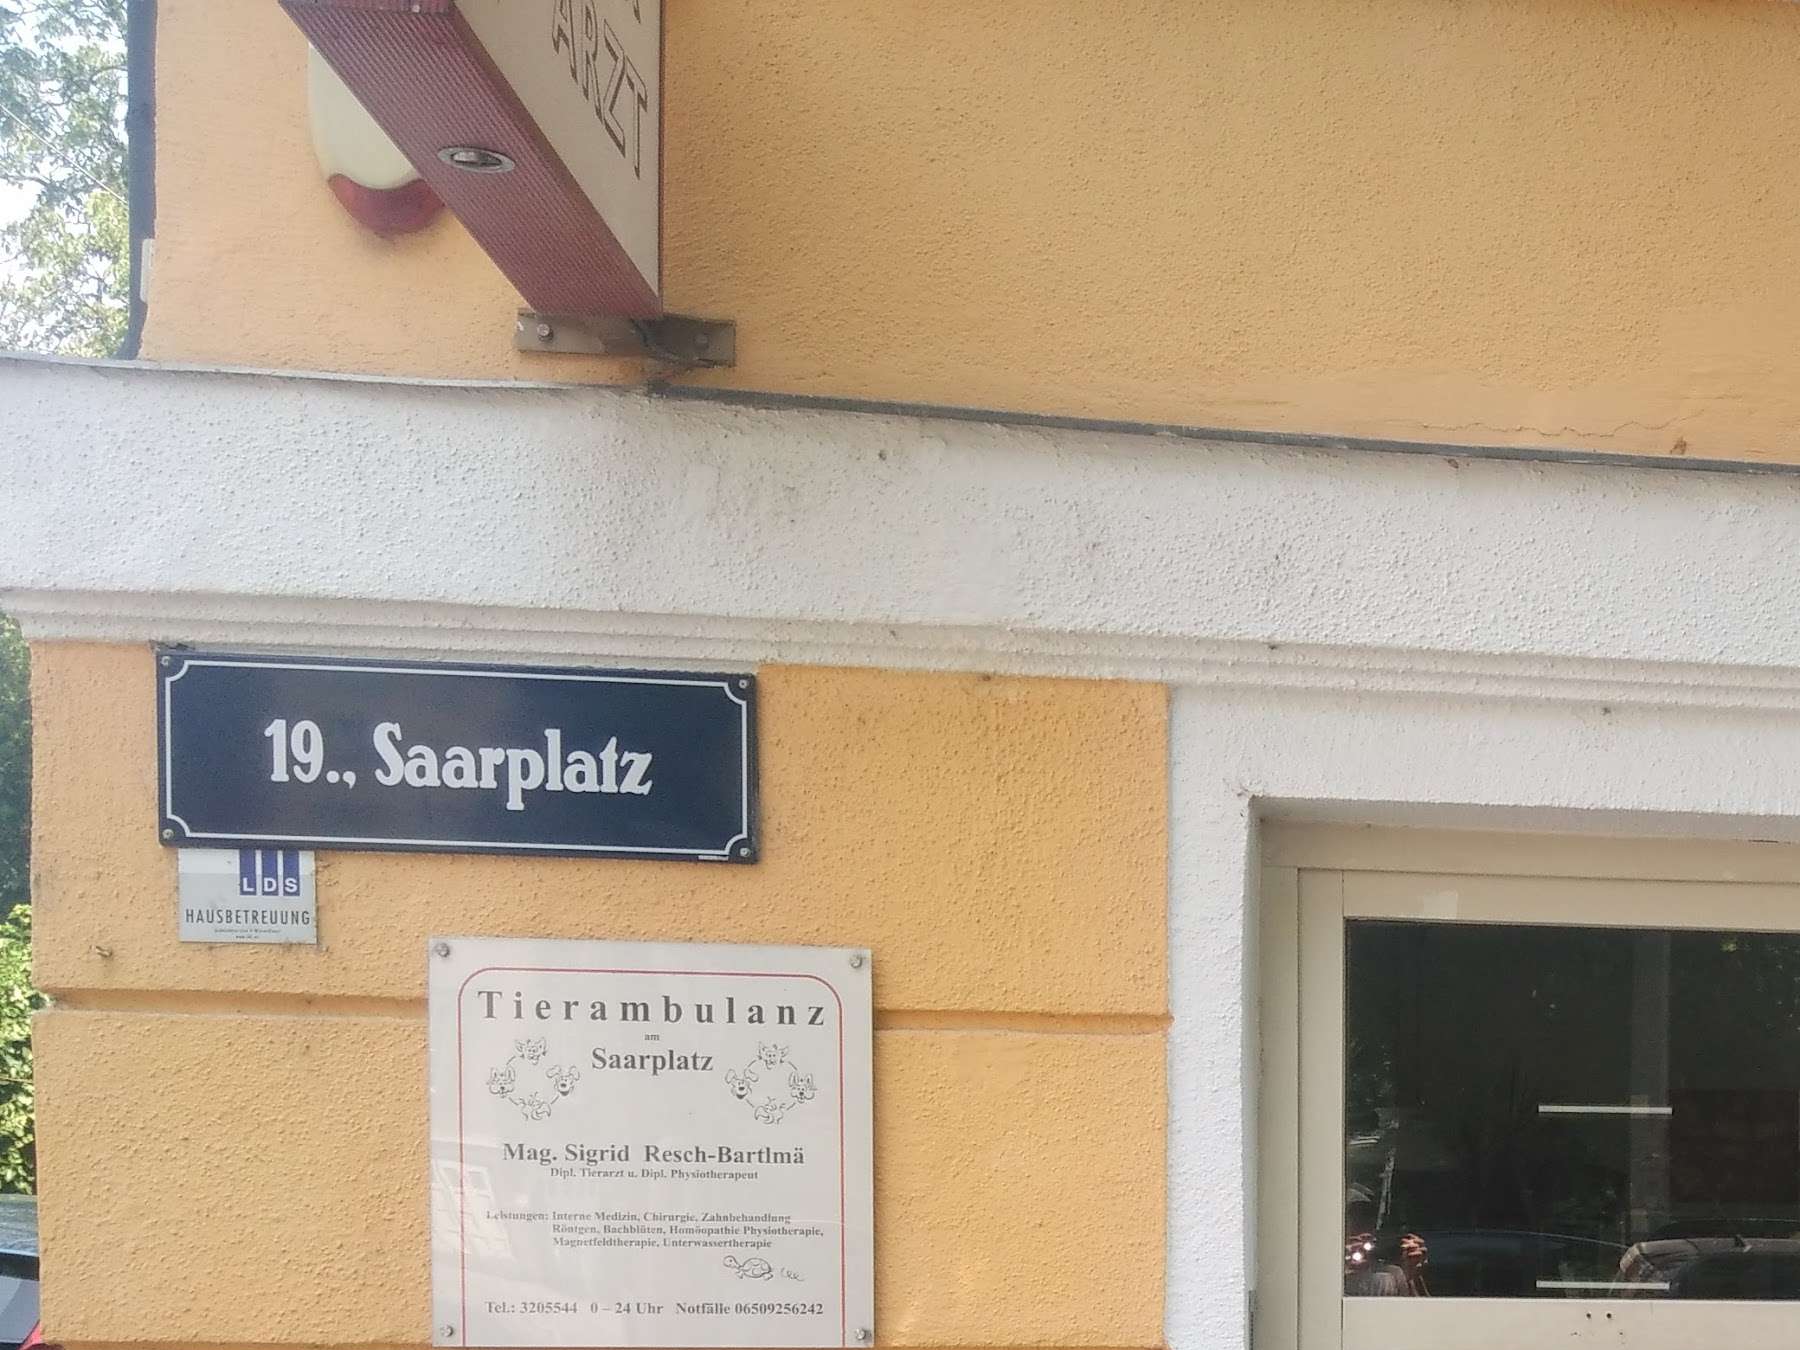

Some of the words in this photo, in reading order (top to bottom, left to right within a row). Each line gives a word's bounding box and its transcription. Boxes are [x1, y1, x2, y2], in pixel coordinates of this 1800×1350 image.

[263, 718, 357, 790] 19.,
[373, 721, 653, 811] Saarplatz
[242, 877, 298, 893] LDS
[185, 908, 310, 925] HAUSBETREUUNG
[477, 990, 825, 1026] Tierambulanz
[644, 1034, 660, 1042] am
[591, 1047, 714, 1076] Saarplatz
[503, 1143, 557, 1166] Mag.
[564, 1143, 629, 1166] Sigrid
[643, 1145, 804, 1164] Resch-Bartlmä
[550, 1167, 576, 1178] Dipl.
[581, 1168, 624, 1178] Tierarzt
[628, 1170, 637, 1178] u.
[641, 1168, 667, 1179] Dipl.
[671, 1169, 759, 1180] Physiotherapeut
[552, 1211, 591, 1221] Interne
[701, 1212, 791, 1224] Zahnbehandlung
[663, 1238, 773, 1250] Unterwassertherapie
[519, 1302, 578, 1315] 3205544
[590, 1302, 598, 1315] 0
[614, 1302, 631, 1315] 24
[635, 1302, 664, 1315] Uhr
[675, 1302, 731, 1316] Notfälle
[734, 1302, 824, 1316] 06509256242
